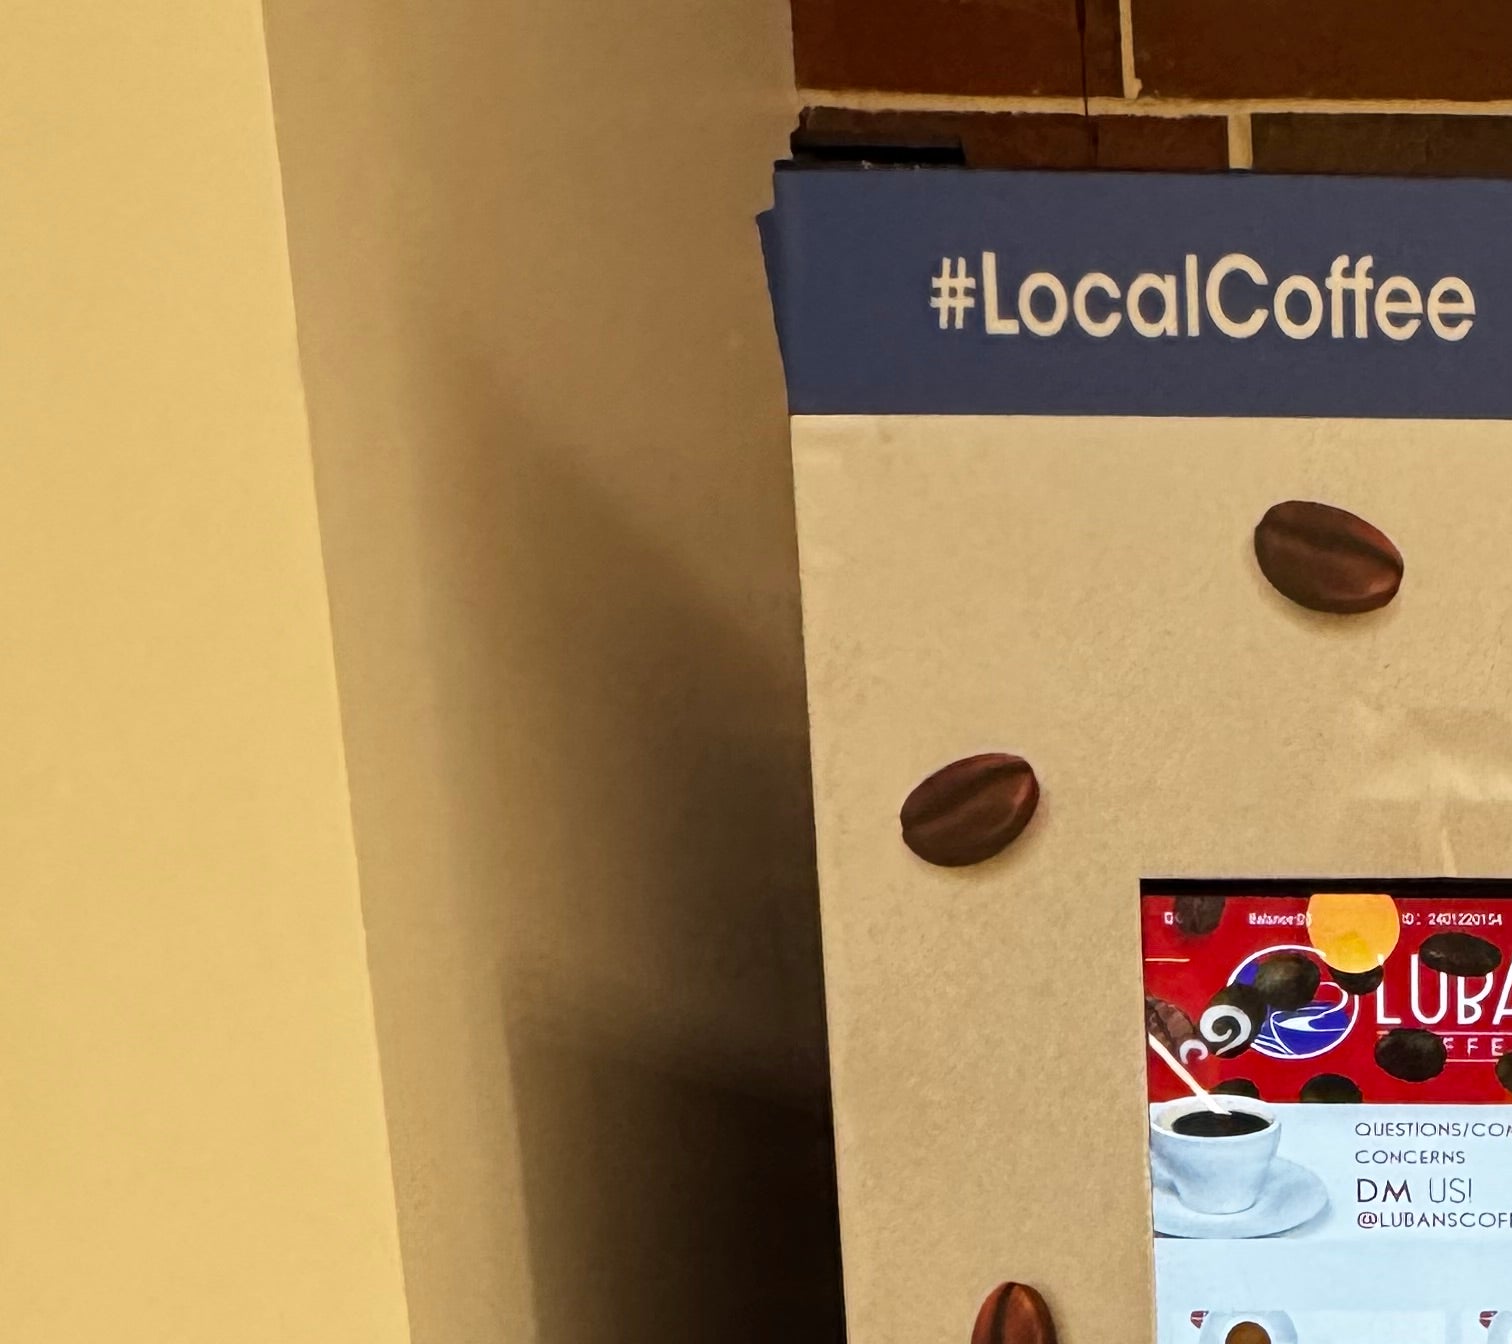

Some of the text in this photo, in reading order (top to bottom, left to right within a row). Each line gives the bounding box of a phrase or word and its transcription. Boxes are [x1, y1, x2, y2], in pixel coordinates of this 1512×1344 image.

[929, 251, 1476, 342] #LocalCoffee
[1355, 1150, 1466, 1165] CONCERNS
[1357, 1177, 1473, 1204] DM US!
